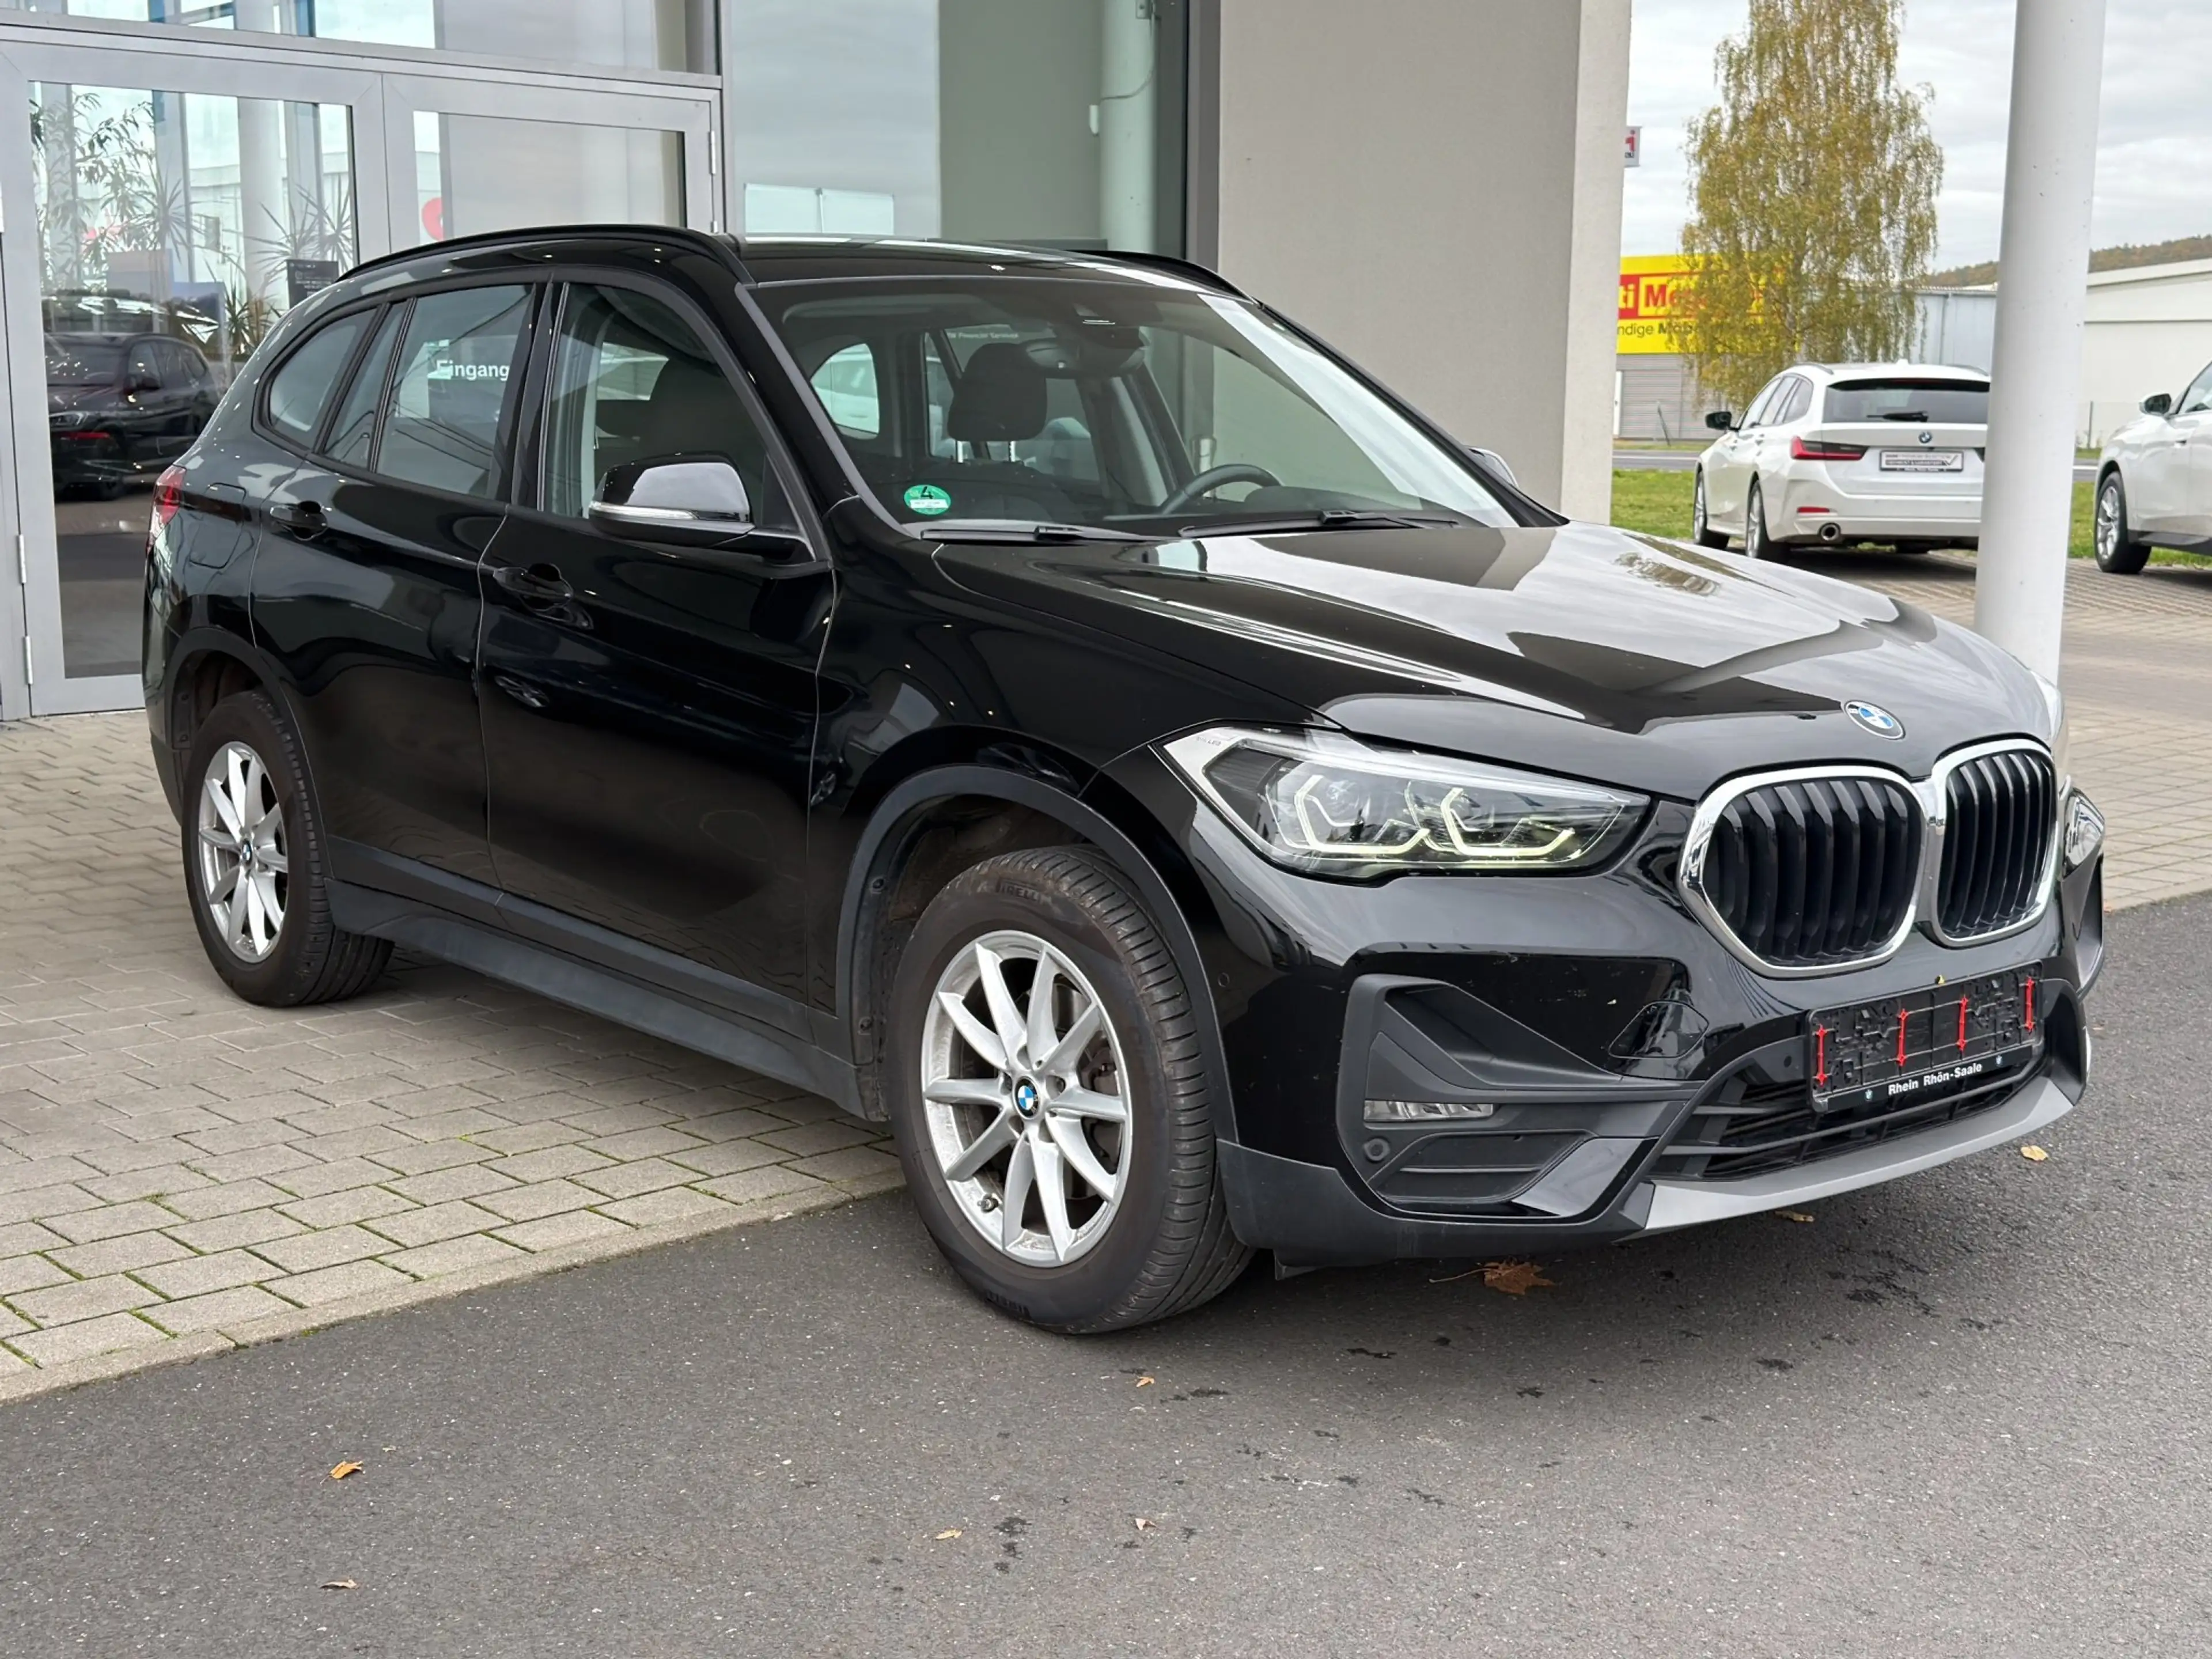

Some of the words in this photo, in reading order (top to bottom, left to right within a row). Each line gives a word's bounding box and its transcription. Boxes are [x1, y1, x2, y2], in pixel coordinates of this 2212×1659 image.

[1619, 284, 1635, 309] ti
[1617, 323, 1654, 338] ndige
[436, 359, 509, 381] Eingang
[921, 486, 934, 499] 4
[1888, 1079, 1919, 1096] Rhein
[1923, 1063, 1983, 1086] Rhön-Saale
